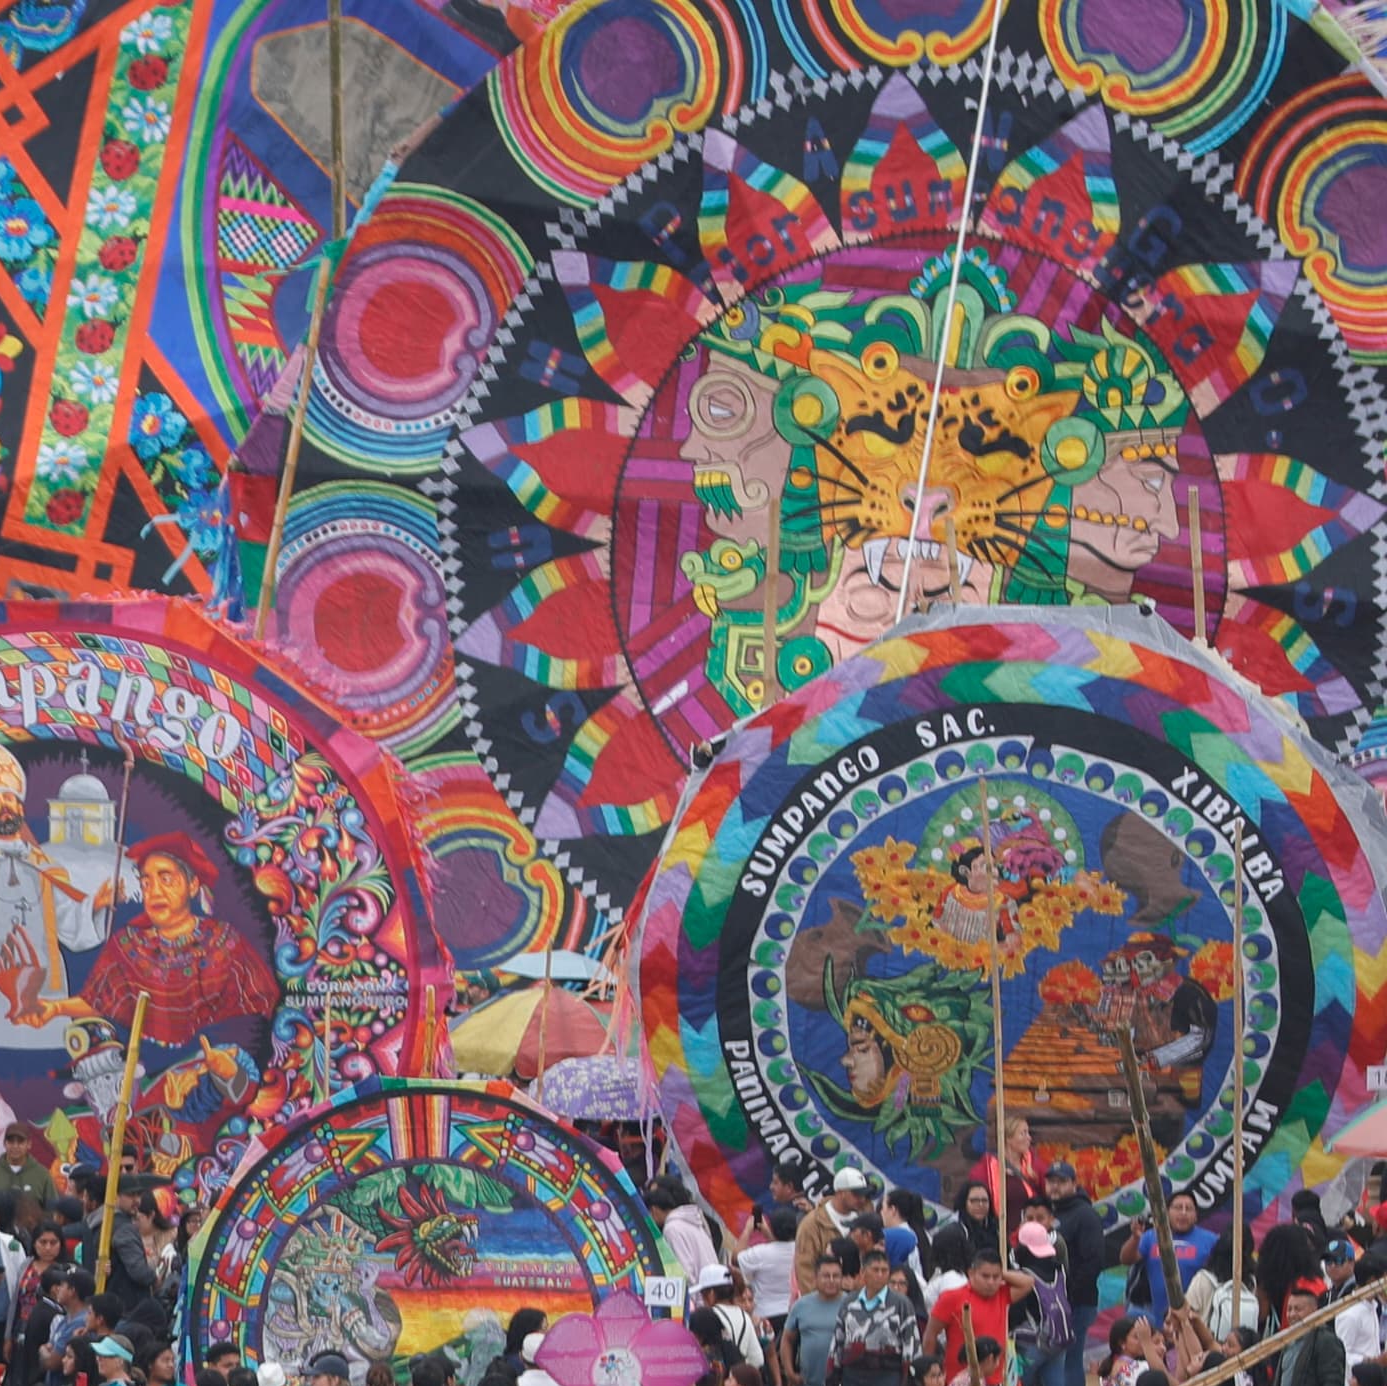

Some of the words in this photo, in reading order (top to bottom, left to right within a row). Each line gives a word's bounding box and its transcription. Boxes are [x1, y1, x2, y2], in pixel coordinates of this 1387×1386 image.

[741, 745, 881, 897] SUMPANGO
[915, 707, 996, 748] SAC.
[1193, 1099, 1278, 1209] UMPAM
[651, 1283, 676, 1300] 40
